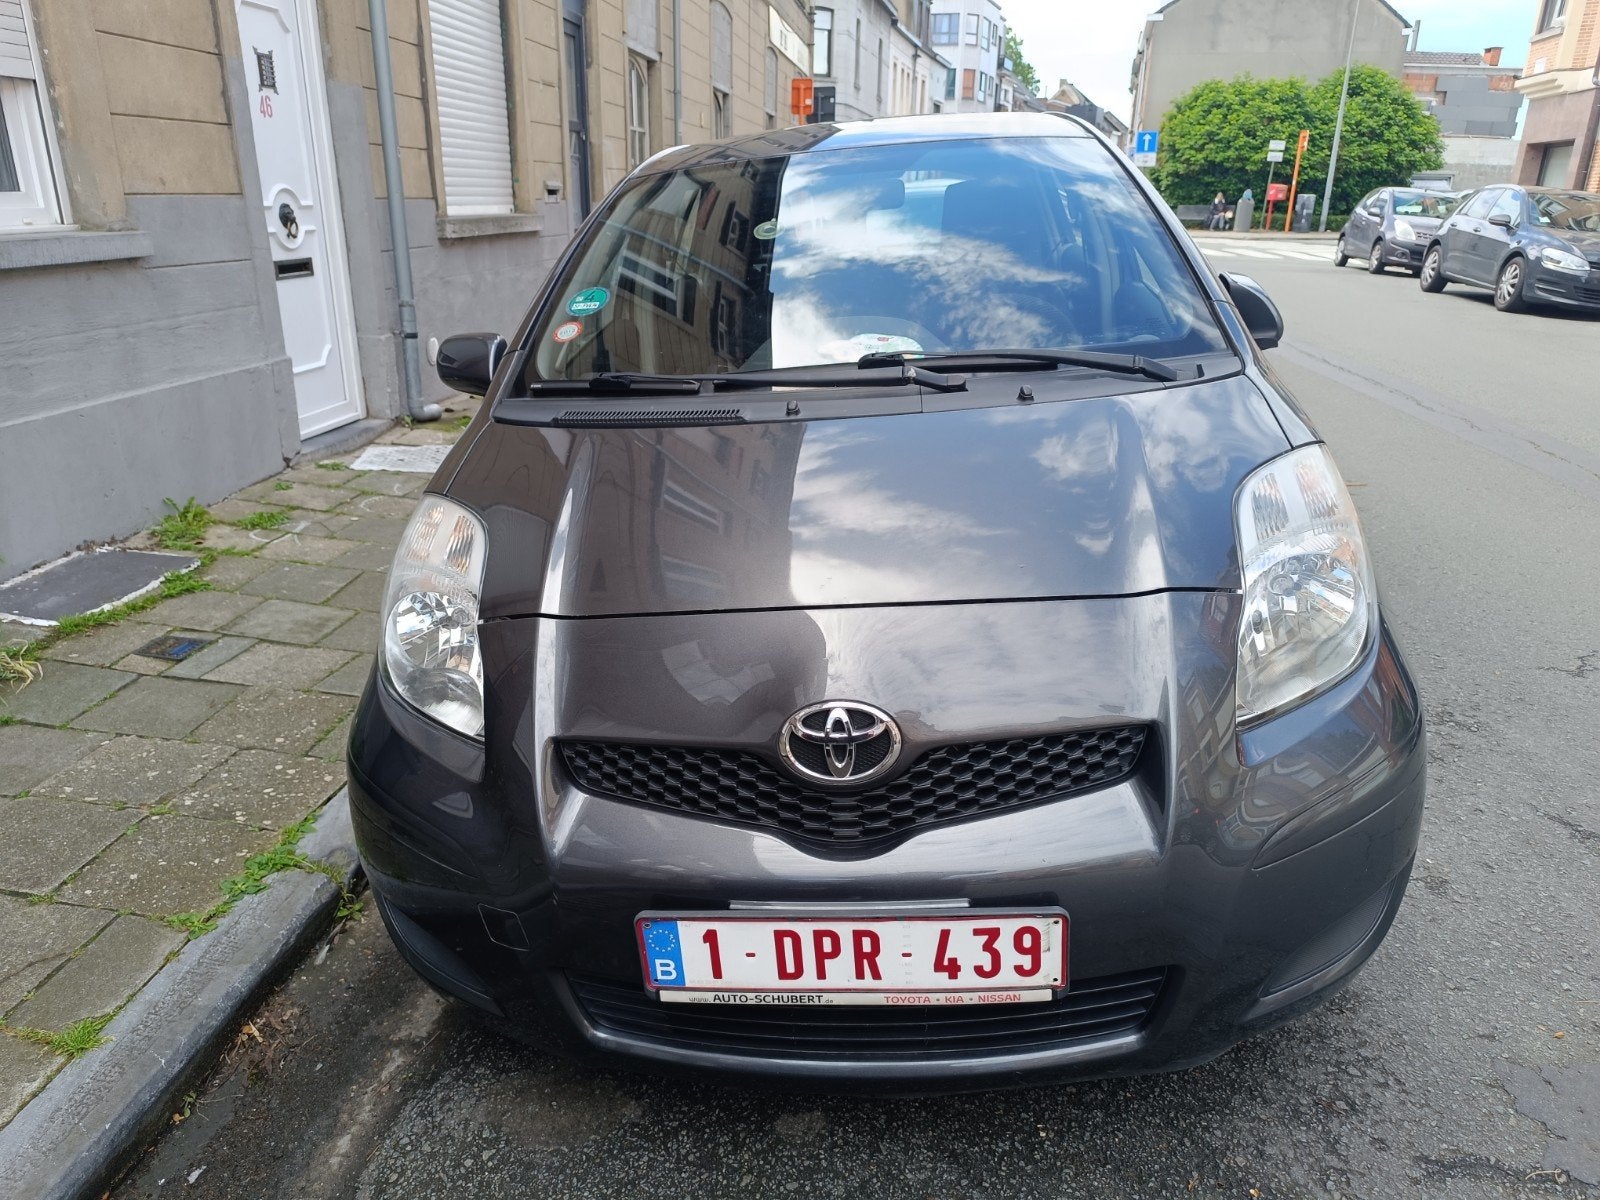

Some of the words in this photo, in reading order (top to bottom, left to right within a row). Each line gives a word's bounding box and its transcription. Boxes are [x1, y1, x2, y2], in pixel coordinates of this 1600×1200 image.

[260, 95, 273, 118] 46
[654, 958, 678, 981] B
[884, 995, 931, 1004] TOYOTA
[945, 995, 965, 1004] KIA
[977, 993, 1021, 1004] NISSAN
